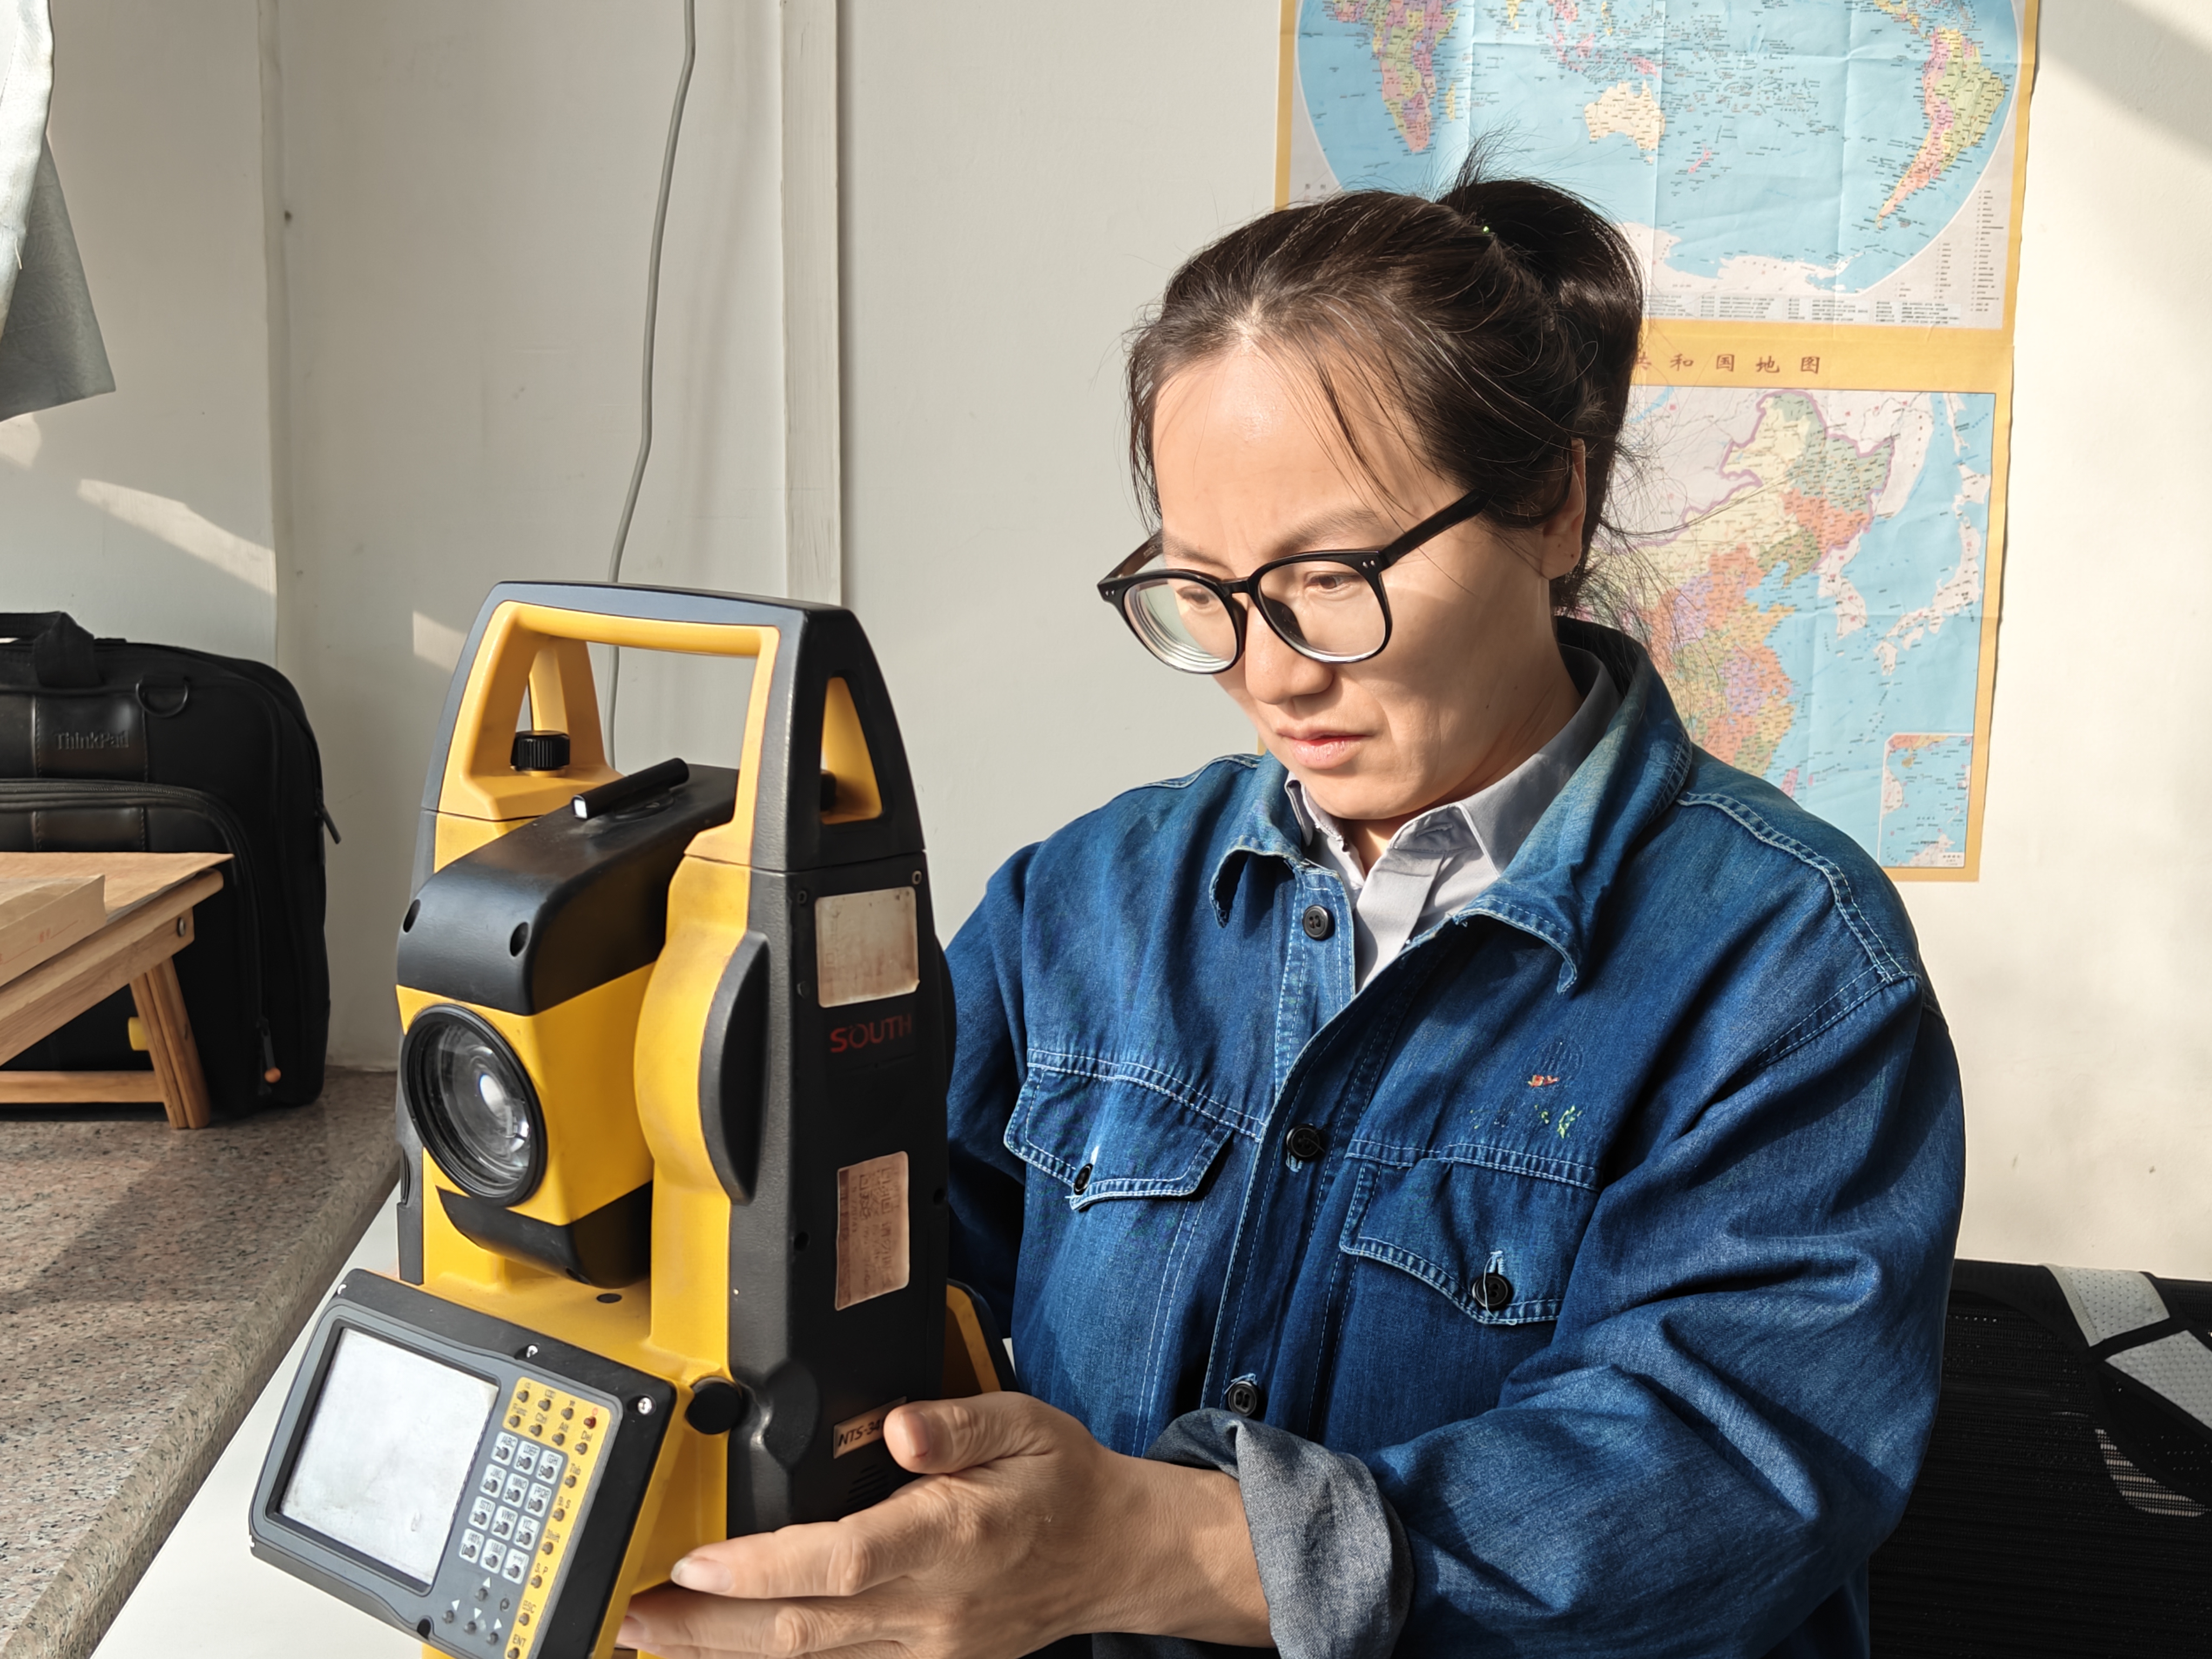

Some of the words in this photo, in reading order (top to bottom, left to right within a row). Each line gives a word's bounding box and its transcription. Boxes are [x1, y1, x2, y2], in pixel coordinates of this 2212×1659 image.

[55, 731, 129, 750] ThinkPad
[830, 1014, 912, 1053] SOUTH
[838, 1419, 883, 1447] NTS-34
[570, 1463, 581, 1475] Tab
[513, 1634, 526, 1647] ENT
